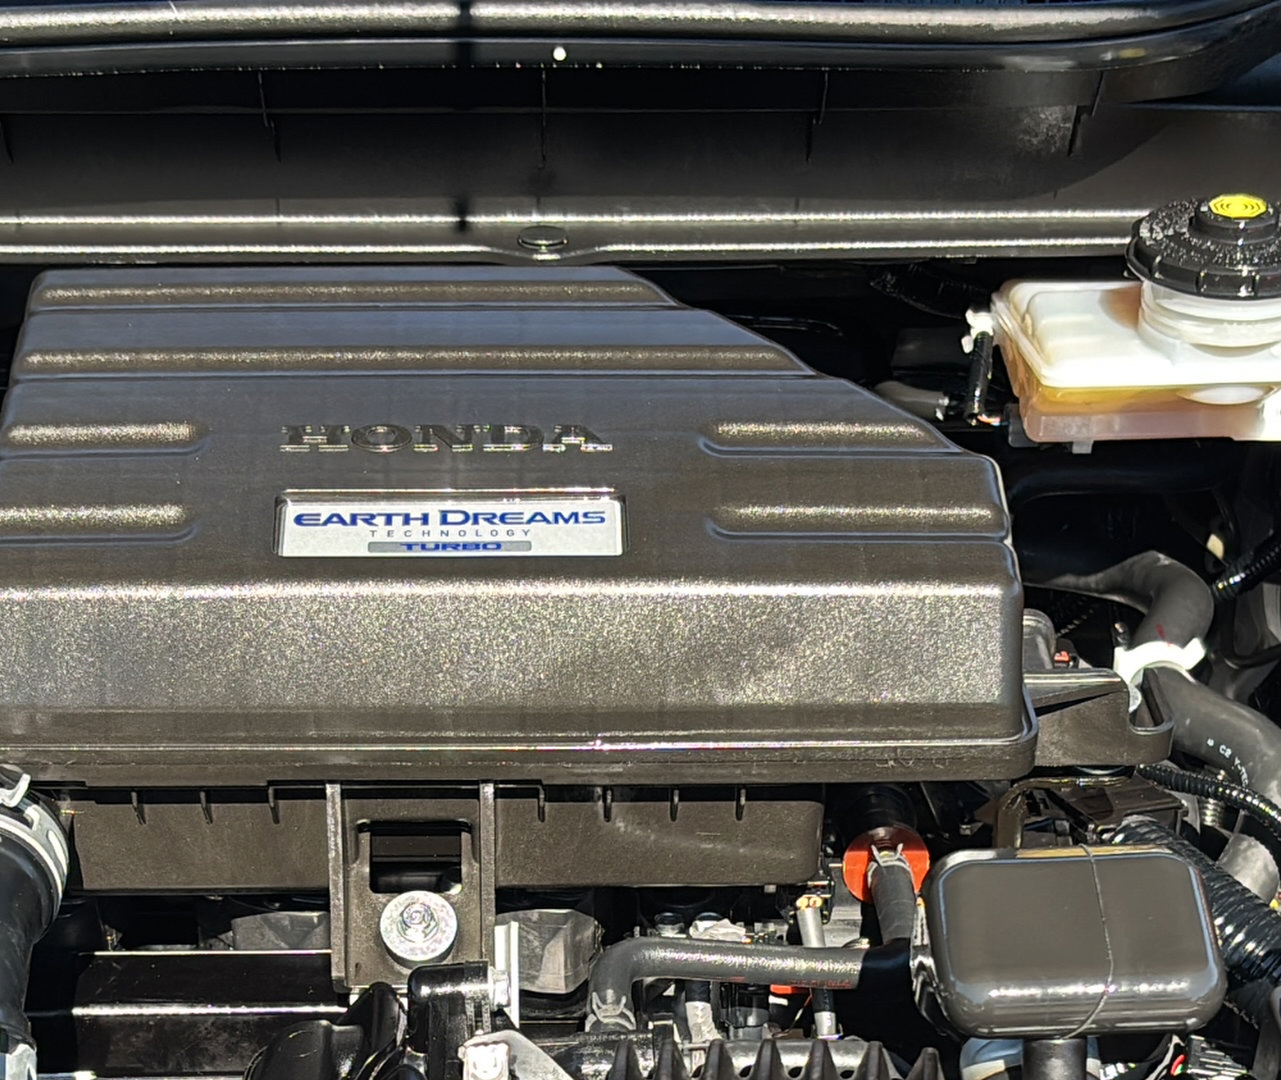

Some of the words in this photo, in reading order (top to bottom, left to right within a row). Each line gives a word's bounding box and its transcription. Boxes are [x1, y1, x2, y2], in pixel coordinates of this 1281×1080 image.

[279, 423, 614, 453] HONDA
[293, 511, 429, 528] EARTH
[439, 509, 607, 526] DREAMS
[370, 529, 532, 538] TECHNOLOGY
[400, 542, 502, 552] TURBO
